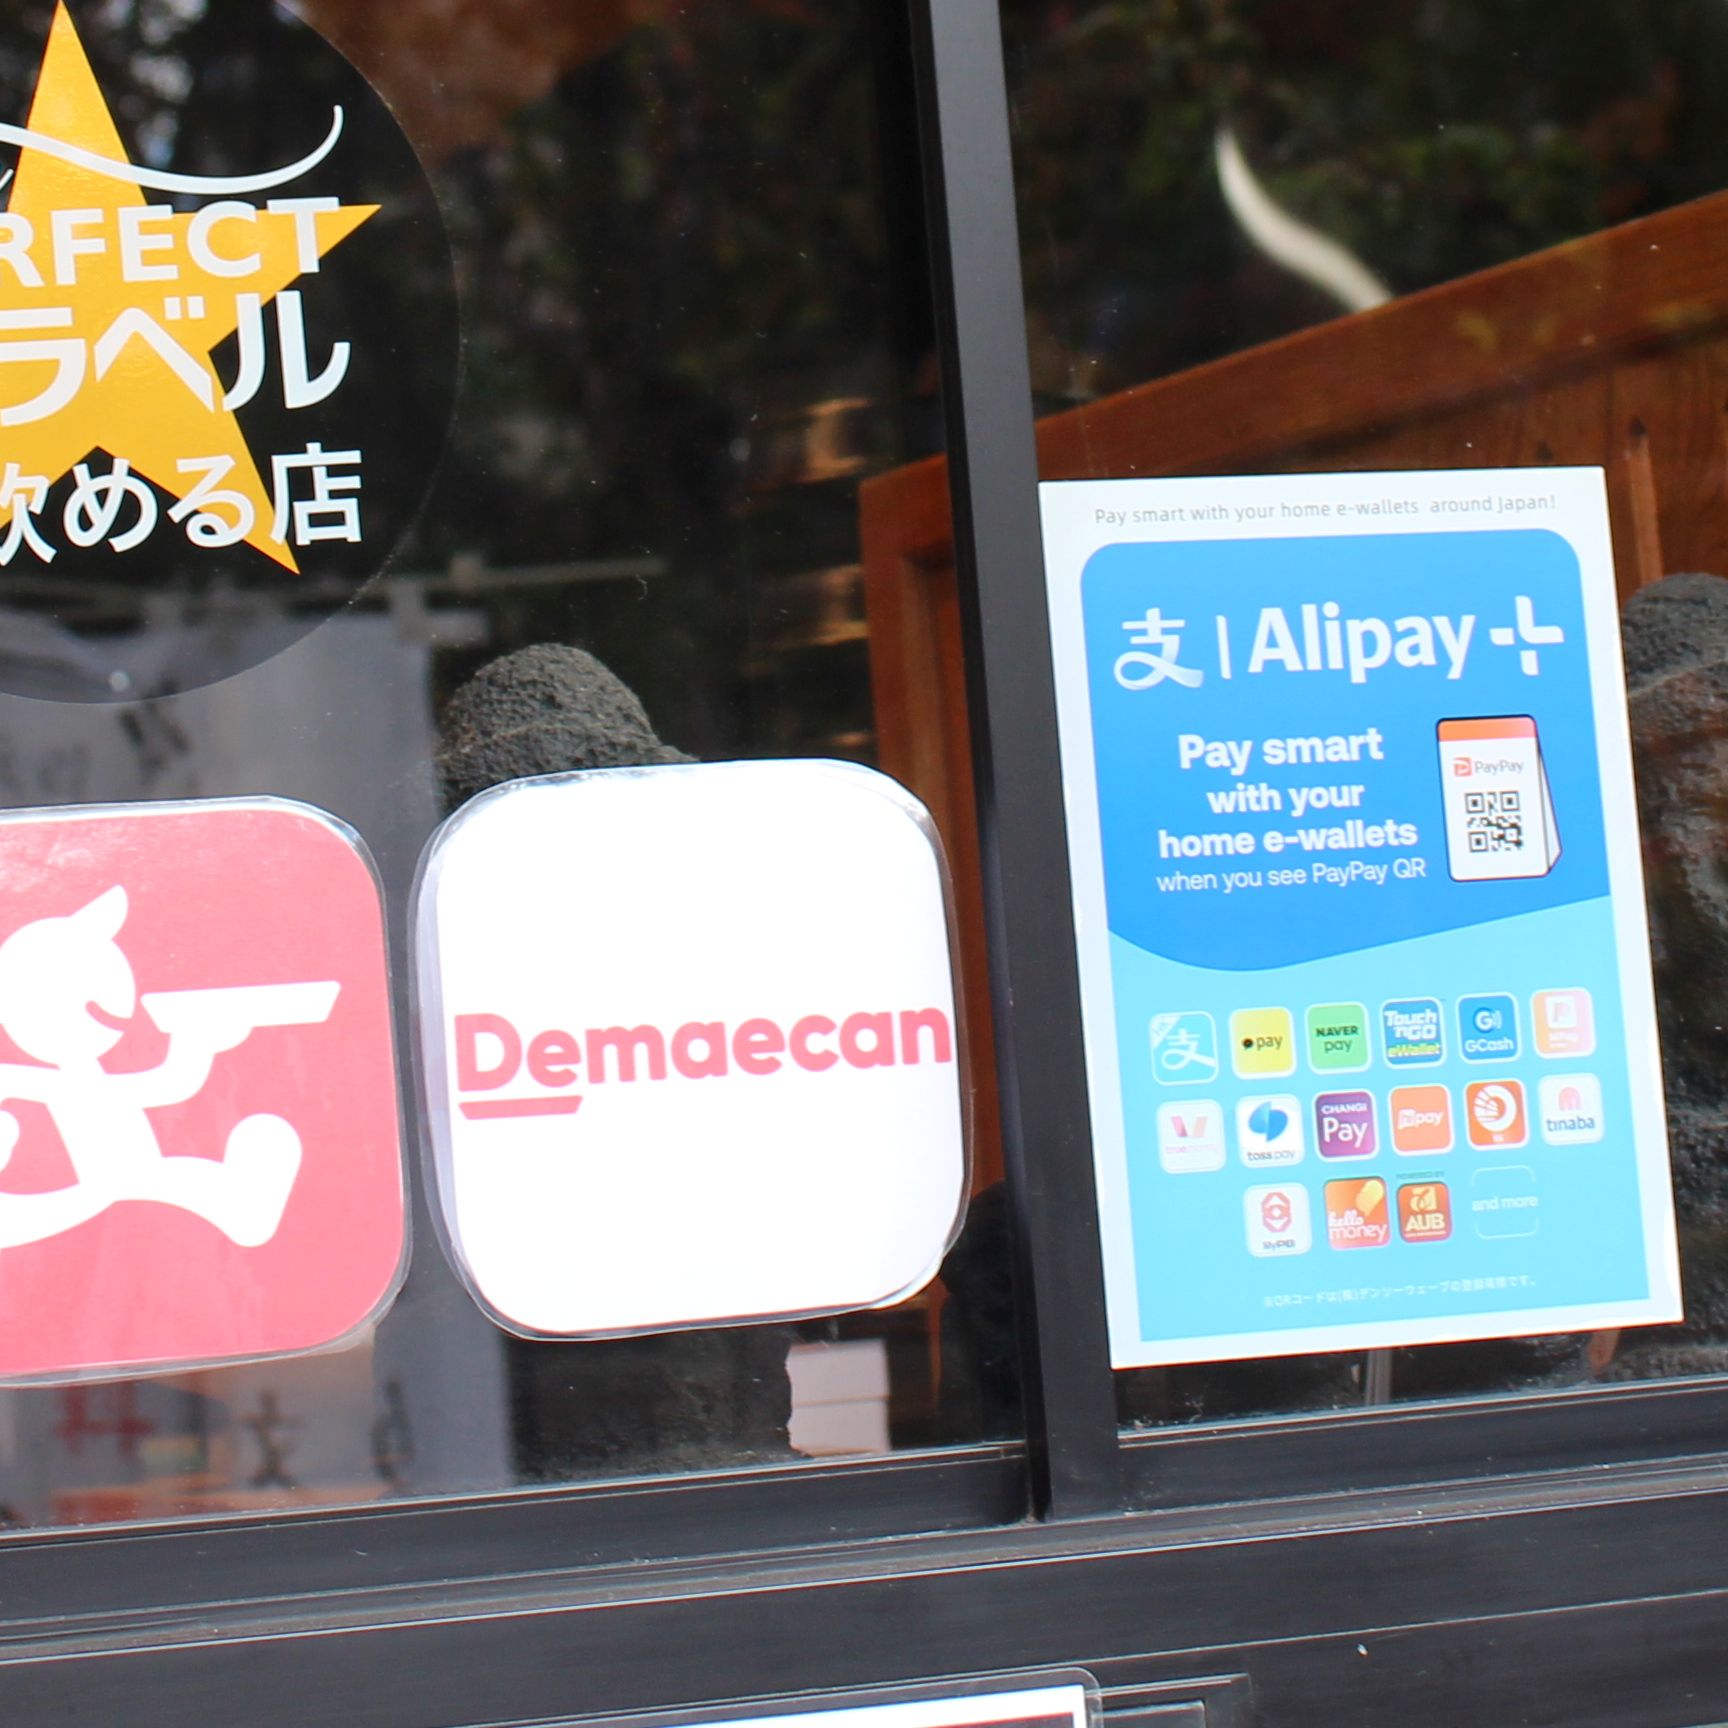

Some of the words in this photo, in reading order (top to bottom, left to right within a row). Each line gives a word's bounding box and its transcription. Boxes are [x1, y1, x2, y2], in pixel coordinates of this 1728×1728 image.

[1095, 508, 1126, 526] Pay
[1133, 506, 1185, 524] smart
[1190, 503, 1230, 521] with
[1234, 504, 1275, 523] your
[1280, 501, 1331, 519] home
[1336, 497, 1419, 517] e-wallets
[1429, 497, 1493, 515] around
[1497, 493, 1557, 516] Japan!
[1178, 732, 1253, 776] Pay
[1262, 727, 1384, 767] smart
[1475, 758, 1524, 775] PayPay
[1207, 783, 1284, 814] with
[1289, 783, 1365, 817] your
[1157, 826, 1255, 859] home
[1263, 818, 1418, 854] e-wallets
[1156, 868, 1217, 893] when
[1222, 870, 1263, 894] you
[1267, 868, 1307, 886] see
[1312, 860, 1389, 888] PayPay
[1393, 856, 1426, 881] QR
[1384, 1008, 1438, 1026] Touch
[1315, 1025, 1359, 1038] NAVER
[453, 1005, 952, 1092] Demaecan
[1256, 1034, 1283, 1051] pay
[1324, 1039, 1353, 1054] pay
[1465, 1037, 1514, 1053] GCash
[1321, 1117, 1368, 1148] Pay
[1546, 1116, 1596, 1132] tinaba
[1472, 1197, 1499, 1211] and
[1502, 1195, 1538, 1209] more
[1405, 1213, 1446, 1232] AUB
[1329, 1224, 1388, 1243] money
